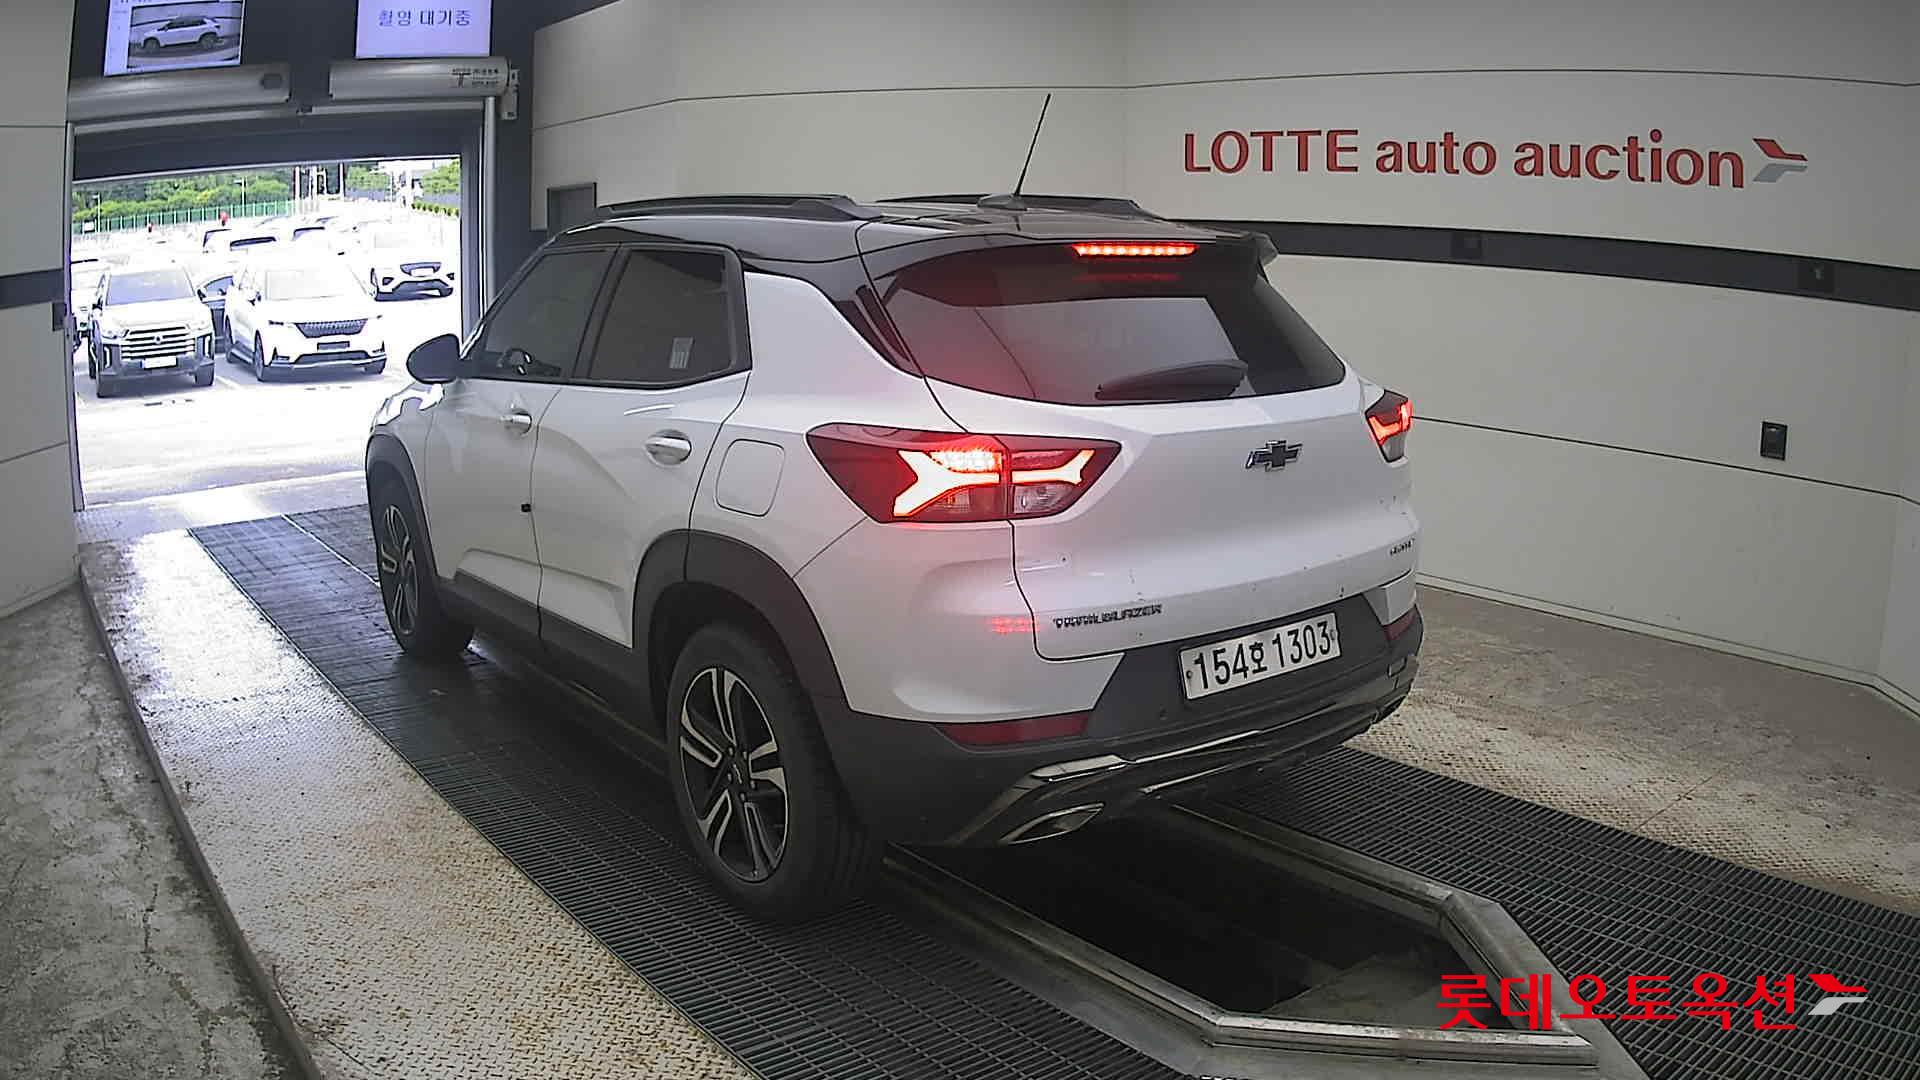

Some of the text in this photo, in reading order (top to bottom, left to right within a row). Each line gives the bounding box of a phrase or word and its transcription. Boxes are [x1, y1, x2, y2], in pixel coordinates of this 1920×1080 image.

[420, 9, 471, 26] 대기중
[1184, 128, 1745, 189] LOTTE auto auction
[1193, 620, 1331, 690] 154호 1303
